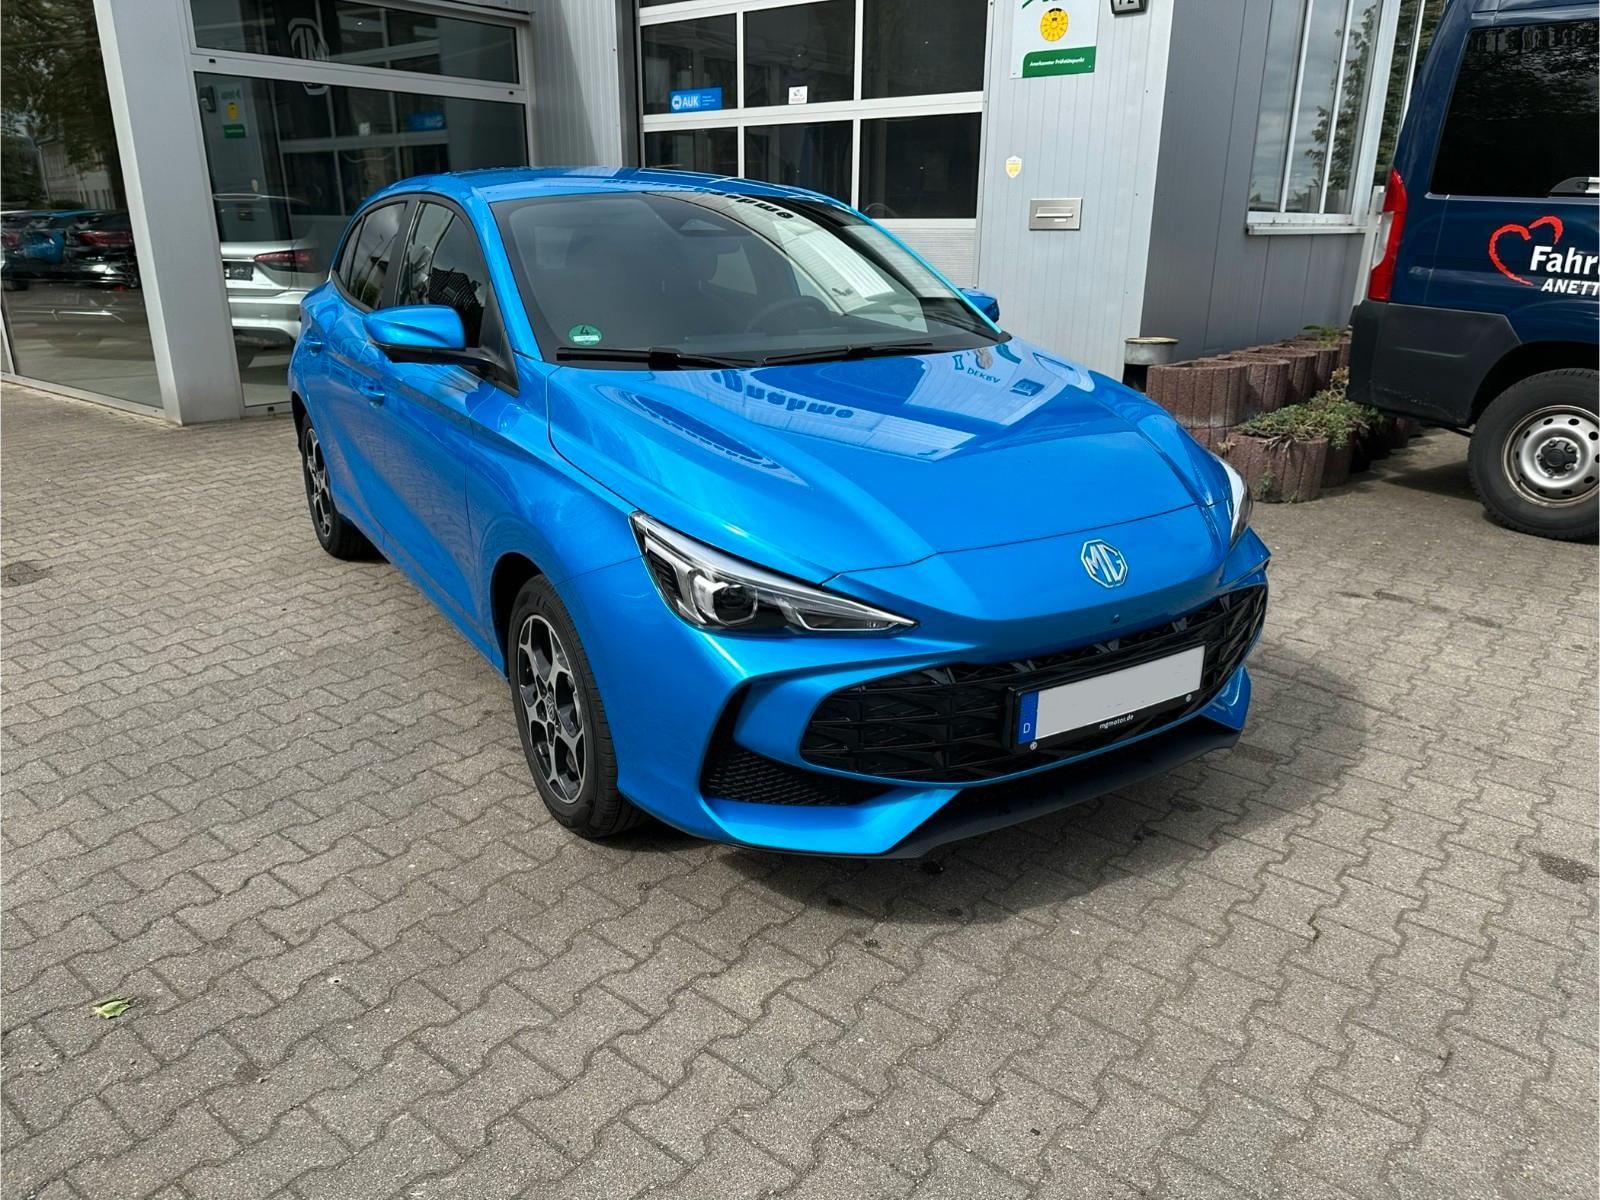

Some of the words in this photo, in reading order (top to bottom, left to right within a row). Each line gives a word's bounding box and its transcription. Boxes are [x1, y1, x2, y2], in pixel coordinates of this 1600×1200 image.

[682, 95, 699, 108] AUK
[1530, 245, 1600, 275] Fahr
[1085, 543, 1125, 582] MG
[1023, 721, 1031, 734] D
[1099, 713, 1134, 729] mgmotor.de
